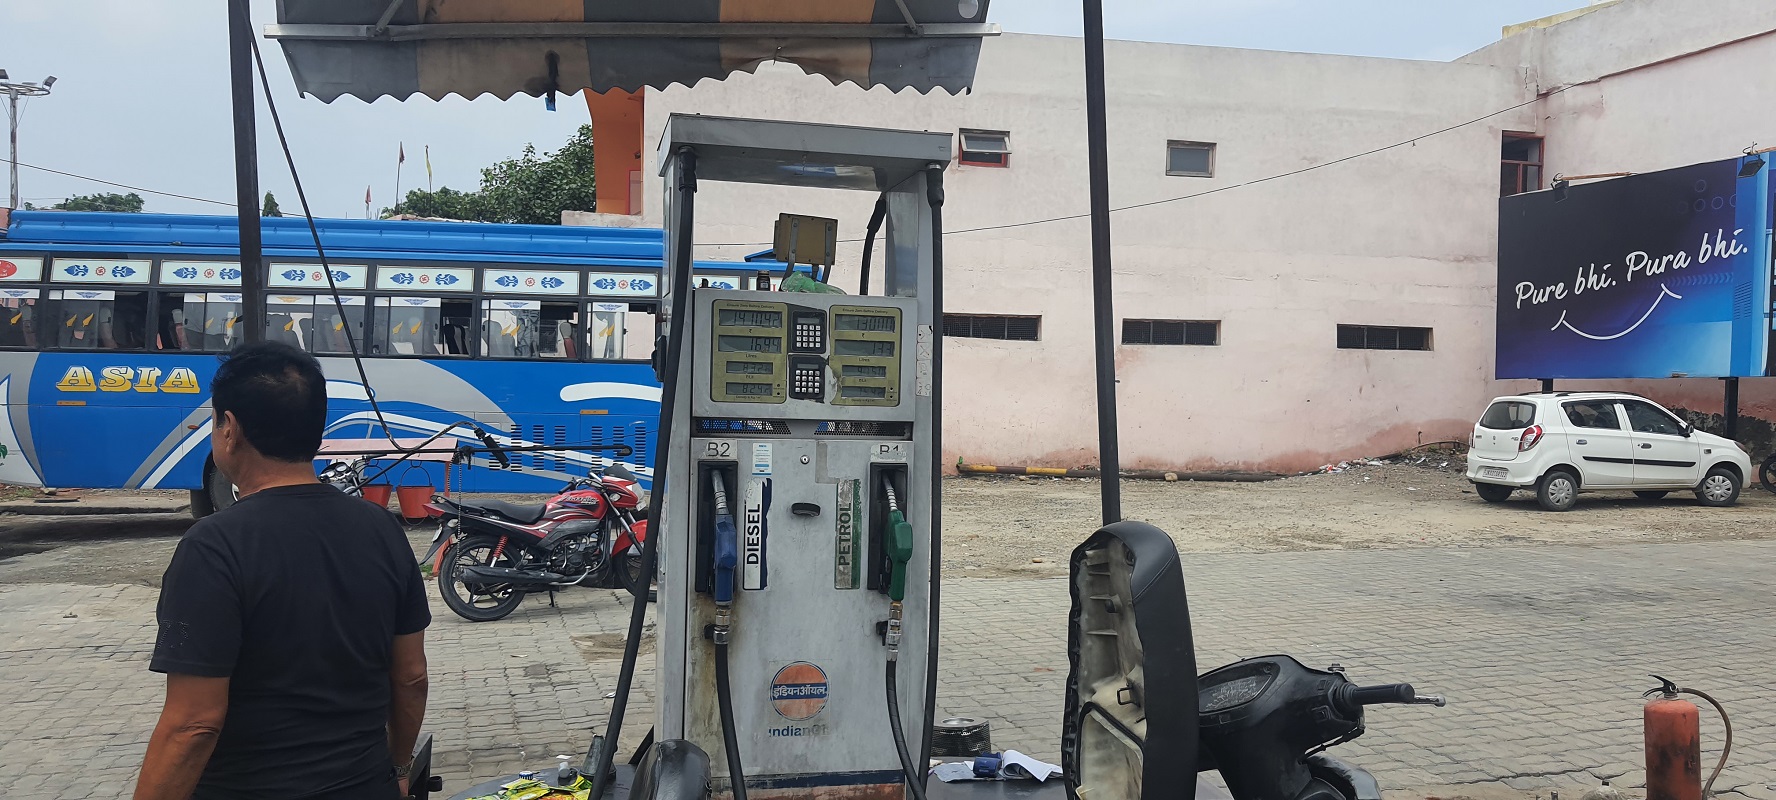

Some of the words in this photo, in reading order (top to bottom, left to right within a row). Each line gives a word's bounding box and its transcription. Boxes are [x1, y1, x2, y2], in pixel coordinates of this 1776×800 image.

[1515, 281, 1568, 309] Pure
[1575, 263, 1617, 295] bhi.
[1625, 250, 1691, 282] Pura
[1698, 228, 1749, 264] bhi.
[56, 365, 200, 393] ASIA
[707, 442, 730, 457] B2
[746, 503, 760, 565] DIESEL
[838, 502, 852, 566] PETROL
[773, 685, 826, 697] इंडियनऑयल
